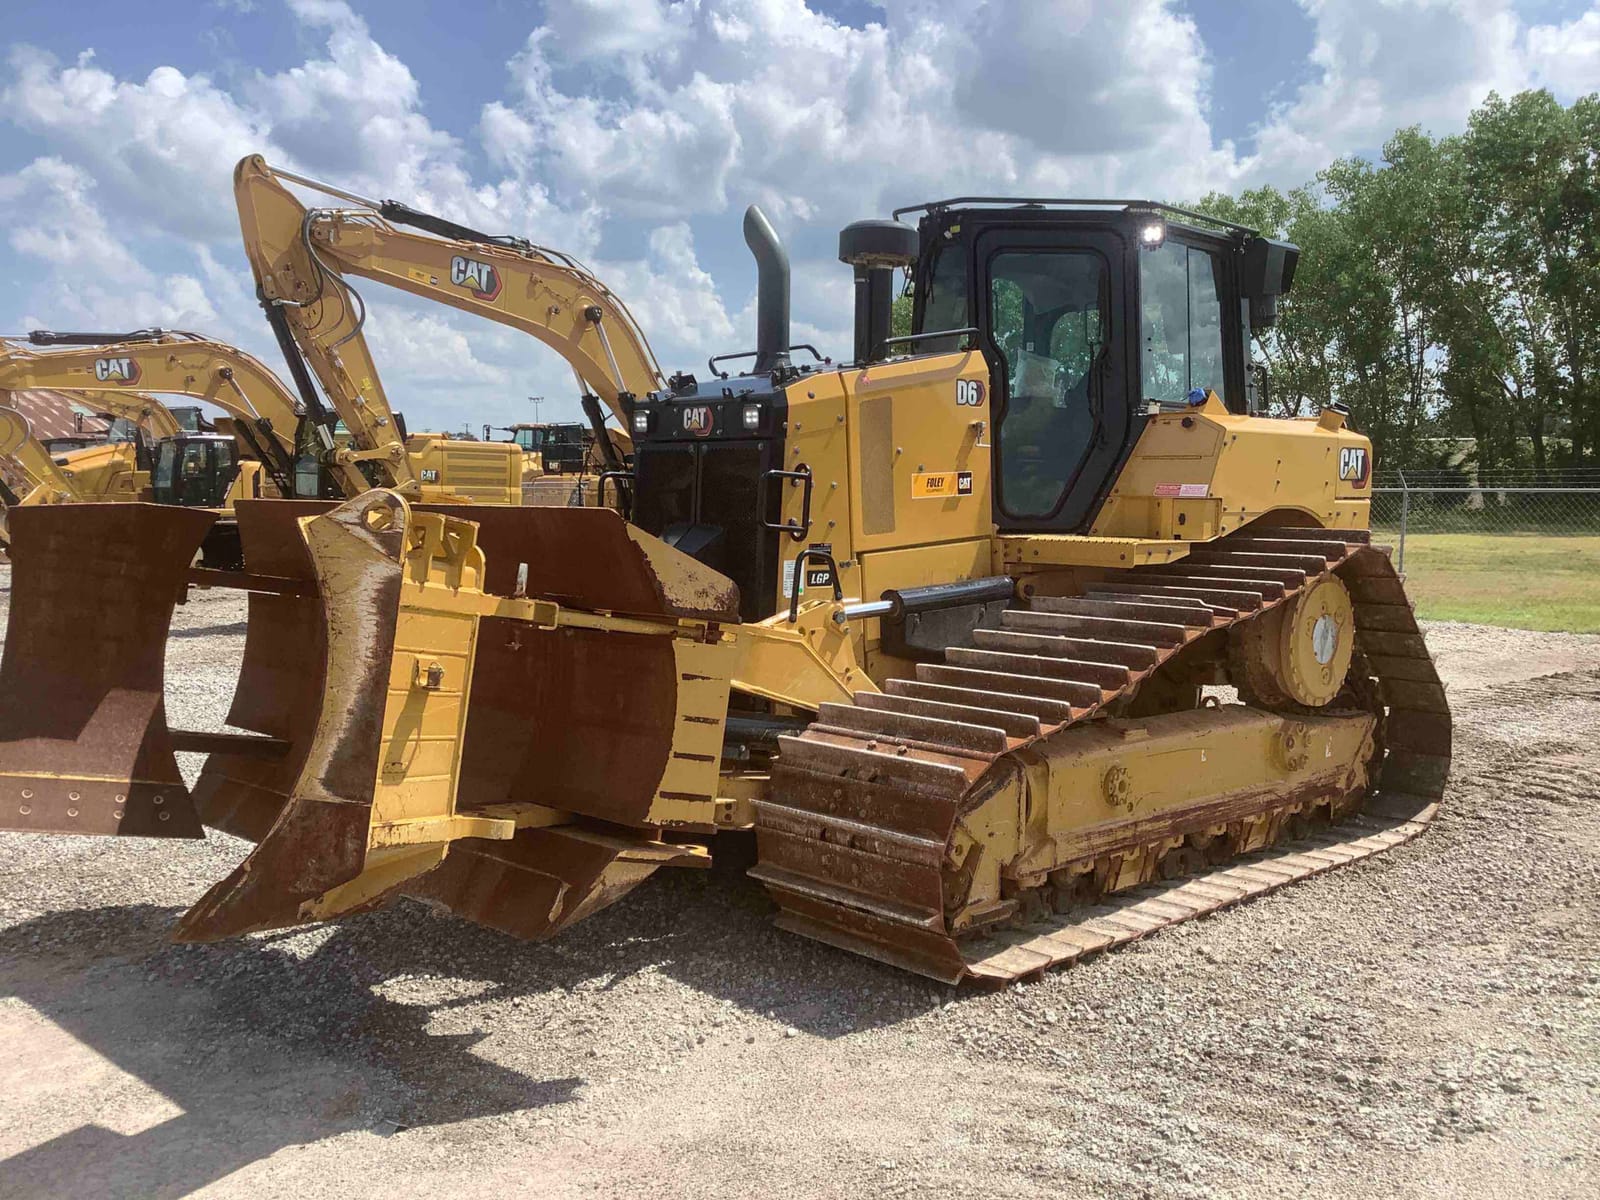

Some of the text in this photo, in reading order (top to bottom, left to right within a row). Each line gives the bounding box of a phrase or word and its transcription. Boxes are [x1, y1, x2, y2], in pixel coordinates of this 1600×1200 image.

[451, 256, 492, 292] CAT
[95, 358, 130, 380] CAT
[957, 380, 977, 405] D6
[683, 407, 707, 429] CAT
[1340, 448, 1365, 480] CAT
[420, 470, 436, 481] CAT
[926, 477, 970, 489] FOLEY CAT
[811, 573, 829, 584] LGP
